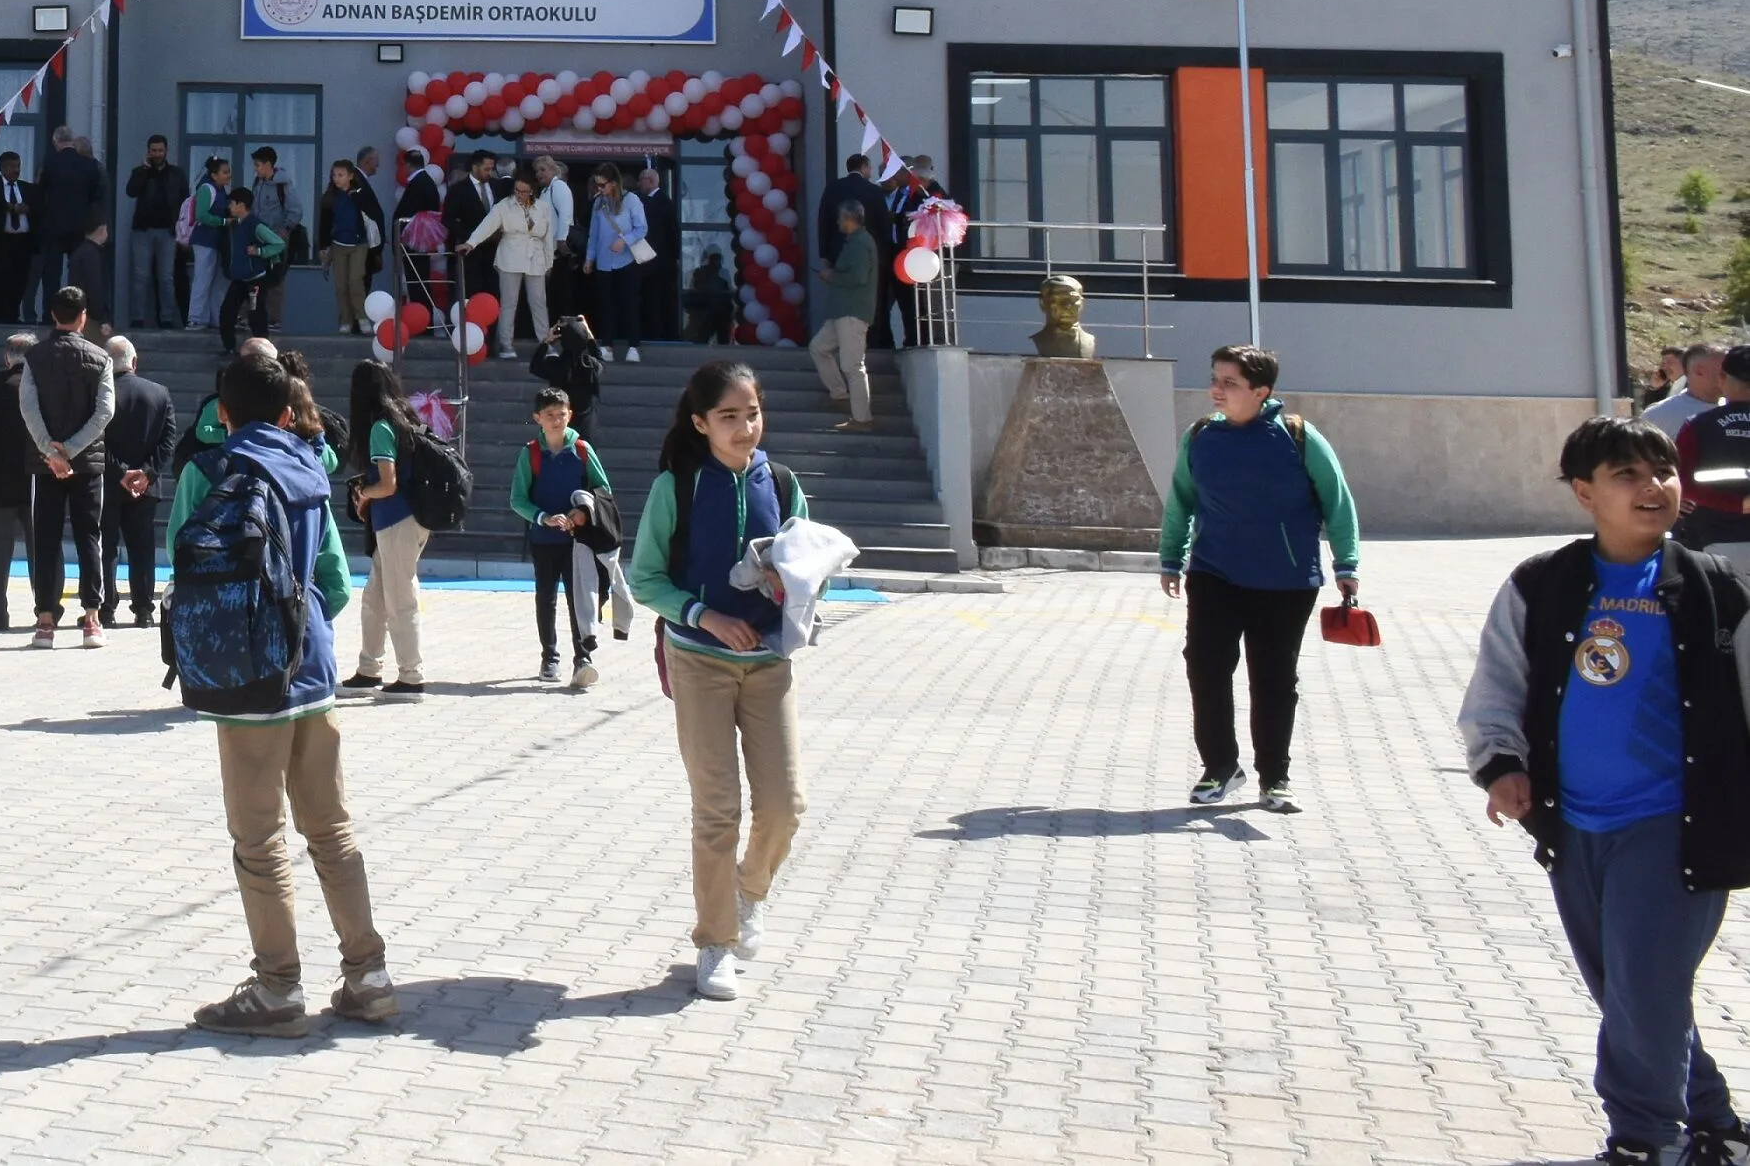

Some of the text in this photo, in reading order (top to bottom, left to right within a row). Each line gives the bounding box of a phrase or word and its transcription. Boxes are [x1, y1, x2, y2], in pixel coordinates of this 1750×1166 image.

[322, 2, 597, 24] ADNAN BAŞDEMİR ORTAOKULU
